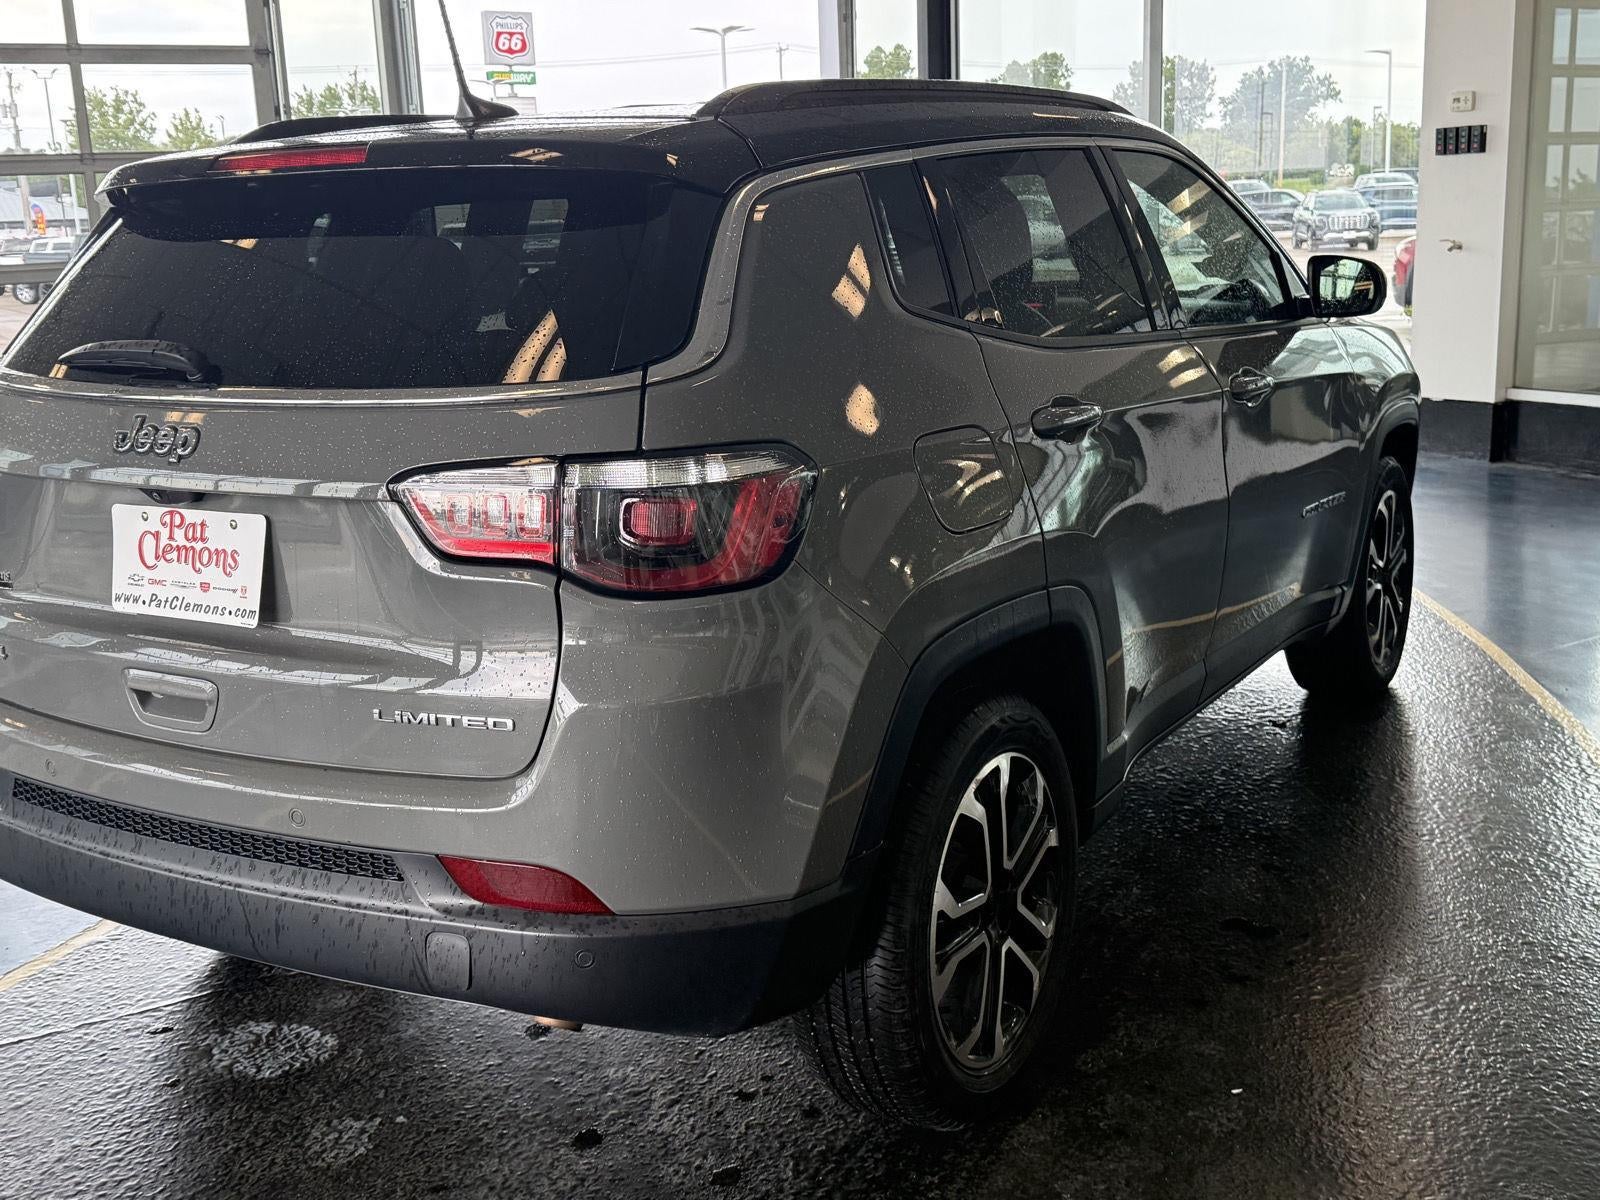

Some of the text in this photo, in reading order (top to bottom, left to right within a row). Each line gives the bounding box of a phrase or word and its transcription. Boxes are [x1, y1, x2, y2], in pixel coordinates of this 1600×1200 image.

[495, 21, 524, 30] PHILLIPS
[497, 33, 523, 51] 66
[113, 414, 202, 465] Jeep
[160, 509, 209, 544] Pat
[138, 530, 240, 578] Clemons
[147, 578, 168, 587] GMC
[114, 592, 257, 620] www.PatClemons.com
[372, 708, 516, 732] LIMITED
